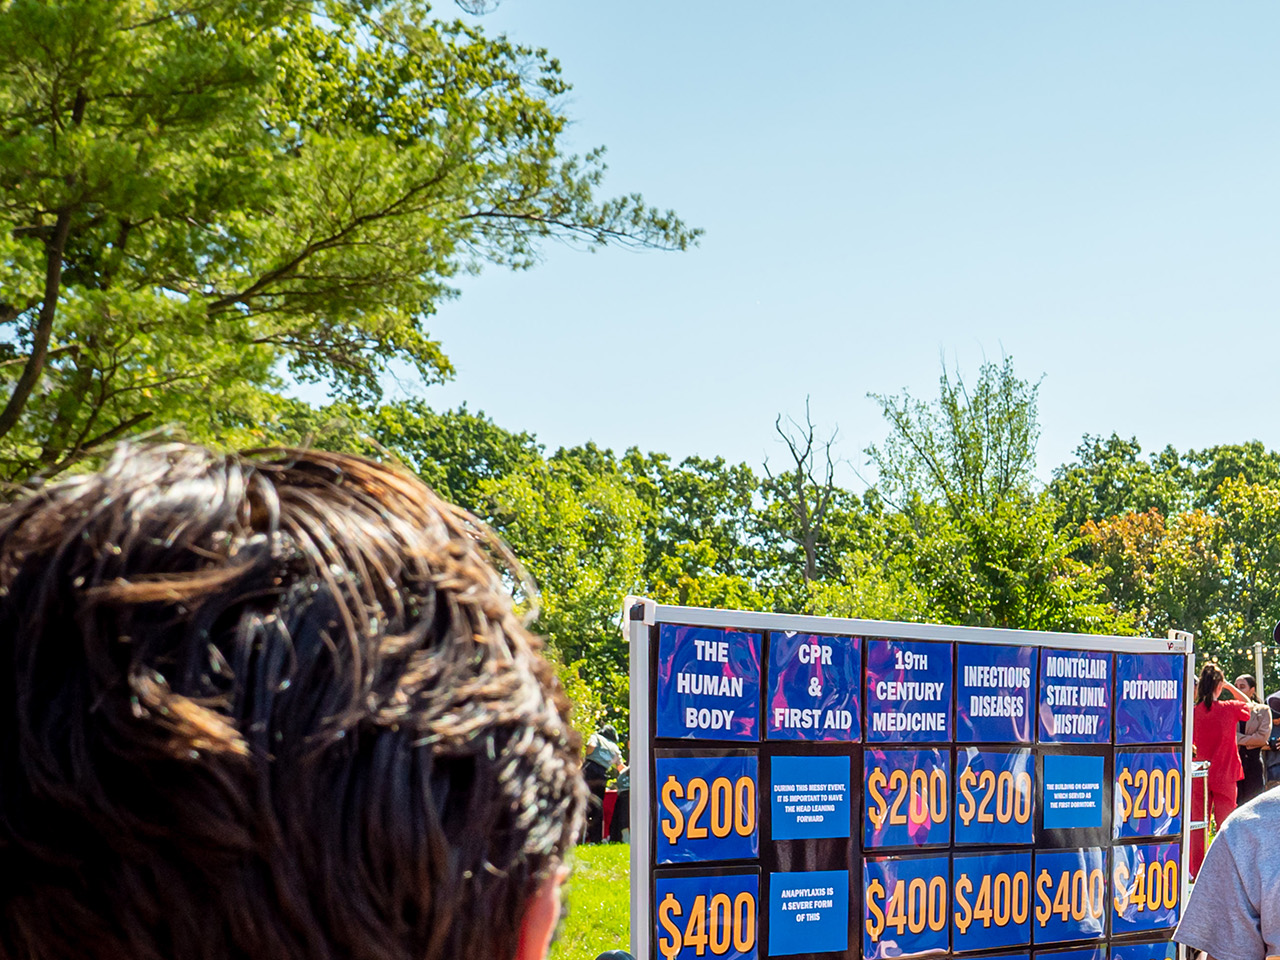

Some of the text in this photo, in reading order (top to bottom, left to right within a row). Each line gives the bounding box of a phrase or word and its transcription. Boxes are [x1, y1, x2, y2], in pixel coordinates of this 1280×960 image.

[694, 640, 729, 662] THE
[799, 644, 832, 665] CPR
[895, 651, 927, 670] 19TH
[964, 666, 1030, 689] INFECTIOUS
[1047, 656, 1107, 679] MONTCLAIR
[677, 673, 743, 697] HUMAN
[808, 677, 822, 696] &
[876, 682, 944, 700] CENTURY
[1046, 685, 1106, 707] STATE UNIV.
[1123, 680, 1177, 700] POTPOURRI
[970, 696, 1023, 717] DISEASES
[686, 708, 734, 730] BODY
[775, 708, 852, 730] FIRST AID
[873, 713, 945, 731] MEDICINE
[1054, 714, 1099, 735] HISTORY
[774, 784, 795, 792] DURING
[828, 784, 846, 792] EVENT,
[868, 767, 948, 830] $200
[959, 767, 1031, 826] $200
[1118, 768, 1180, 822] $200
[662, 775, 755, 844] $200
[785, 805, 795, 813] THE
[797, 815, 824, 823] FORWARD
[781, 887, 833, 898] ANAPHYLAXIS IS
[1036, 869, 1104, 927] $400
[1114, 860, 1177, 917] $400
[782, 900, 832, 910] A SEVERE FORM
[866, 875, 947, 942] $400
[955, 871, 1028, 934] $400
[796, 913, 820, 922] OF THIS
